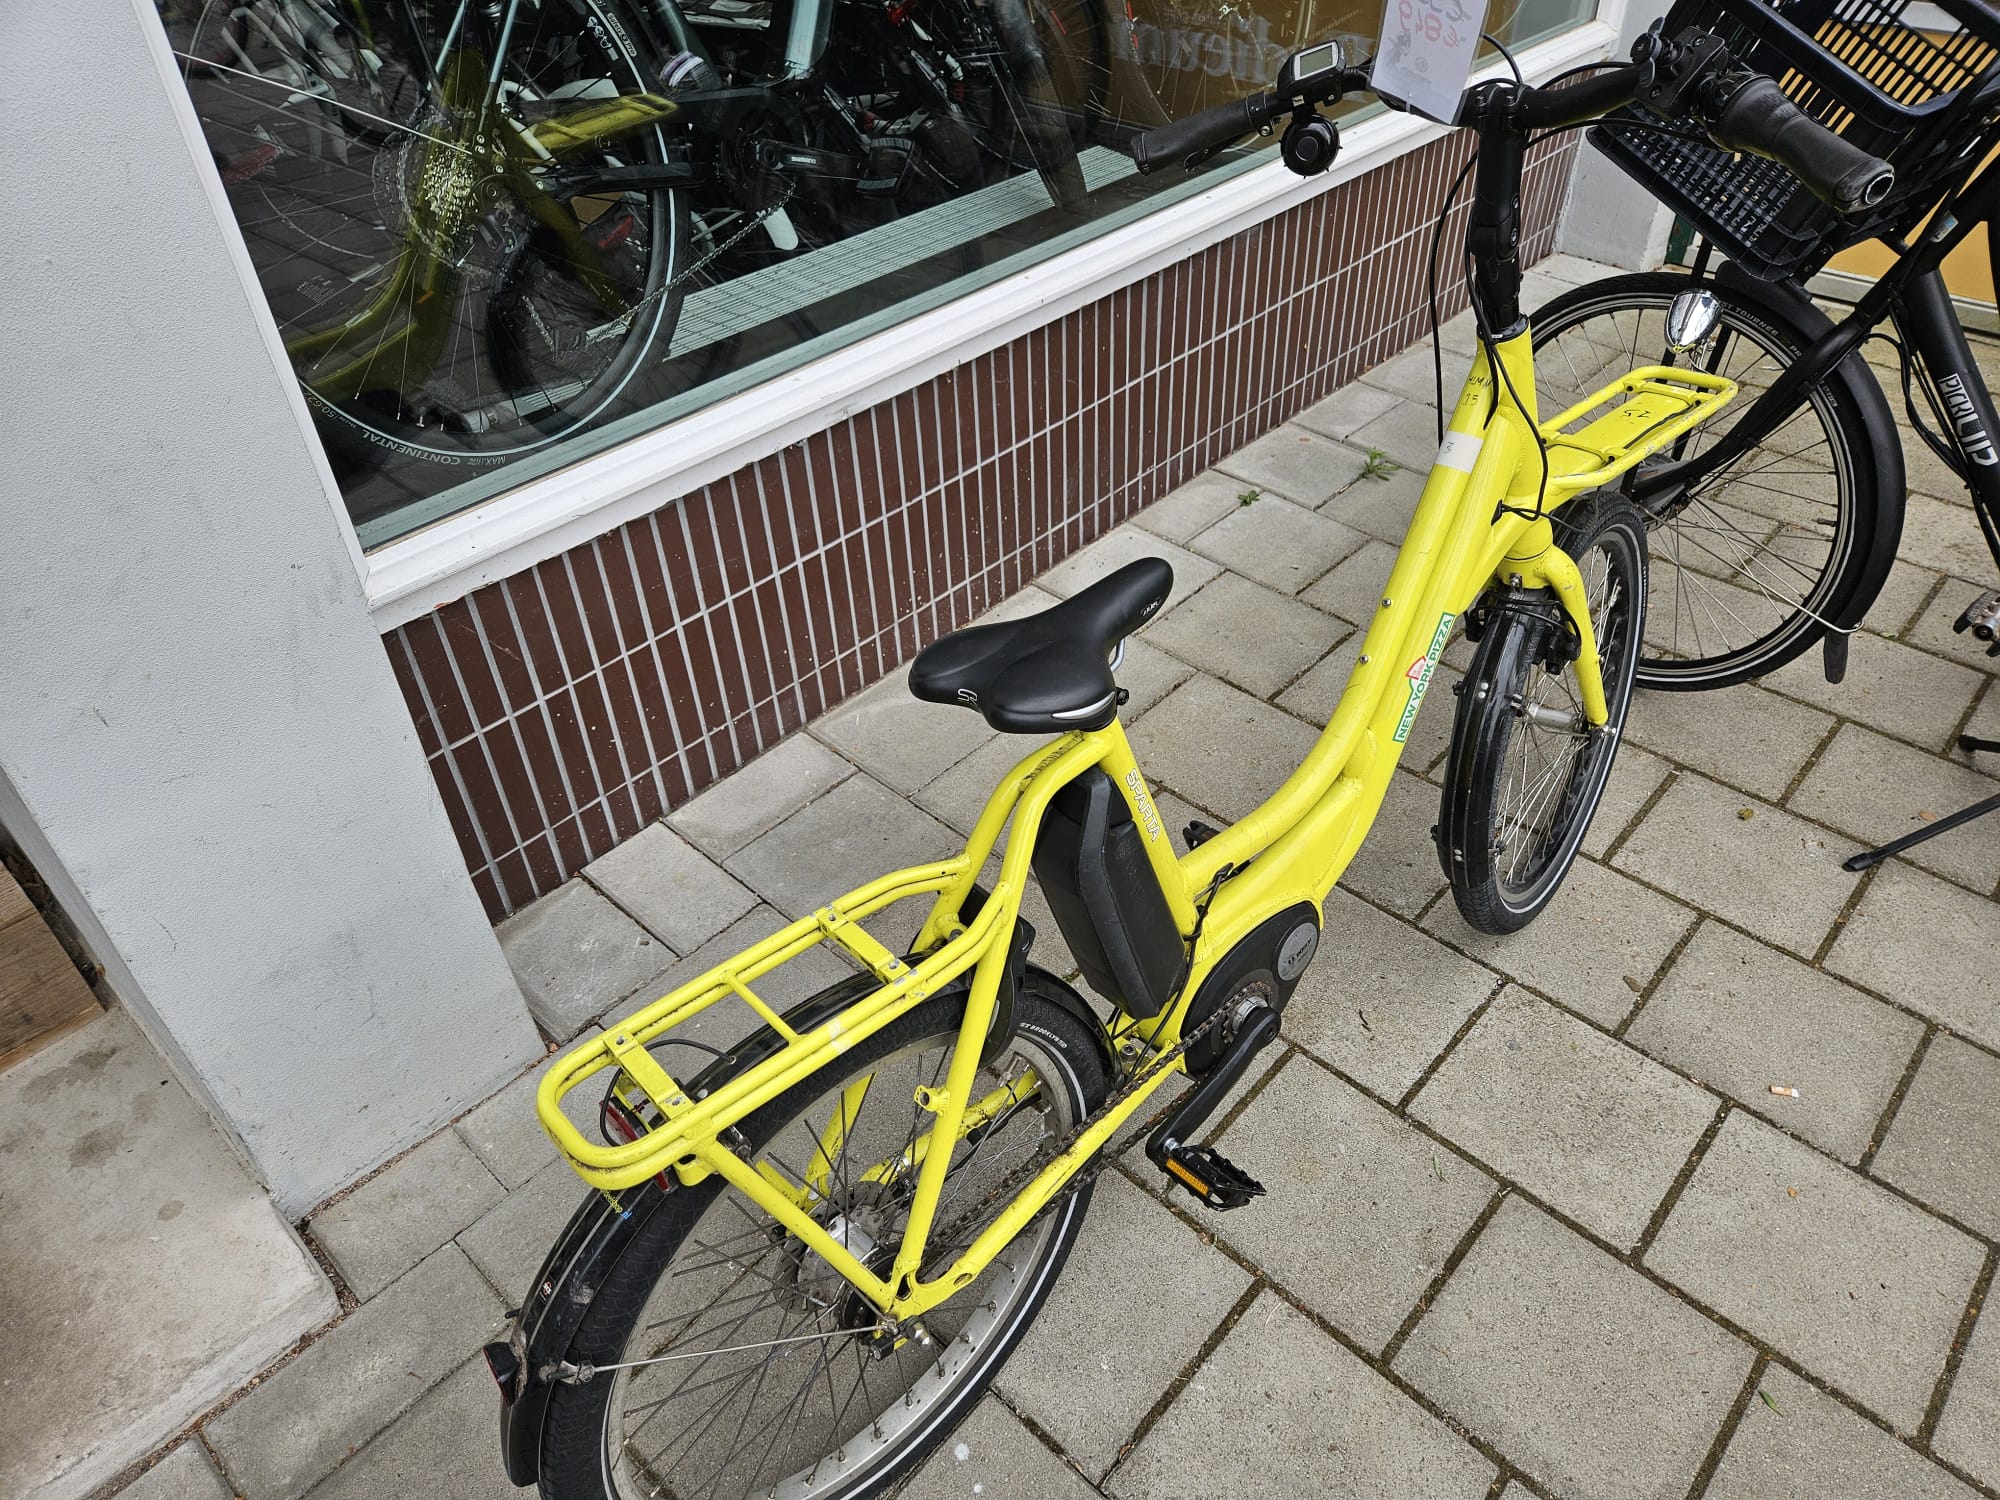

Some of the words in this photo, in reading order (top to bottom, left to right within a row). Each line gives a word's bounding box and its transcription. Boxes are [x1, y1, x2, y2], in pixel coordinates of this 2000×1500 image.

[362, 428, 461, 466] CONTINENTAL
[1397, 704, 1416, 739] NEW
[1412, 663, 1434, 702] YORK
[1428, 618, 1452, 661] PIZZA
[1126, 768, 1161, 842] SPARTA
